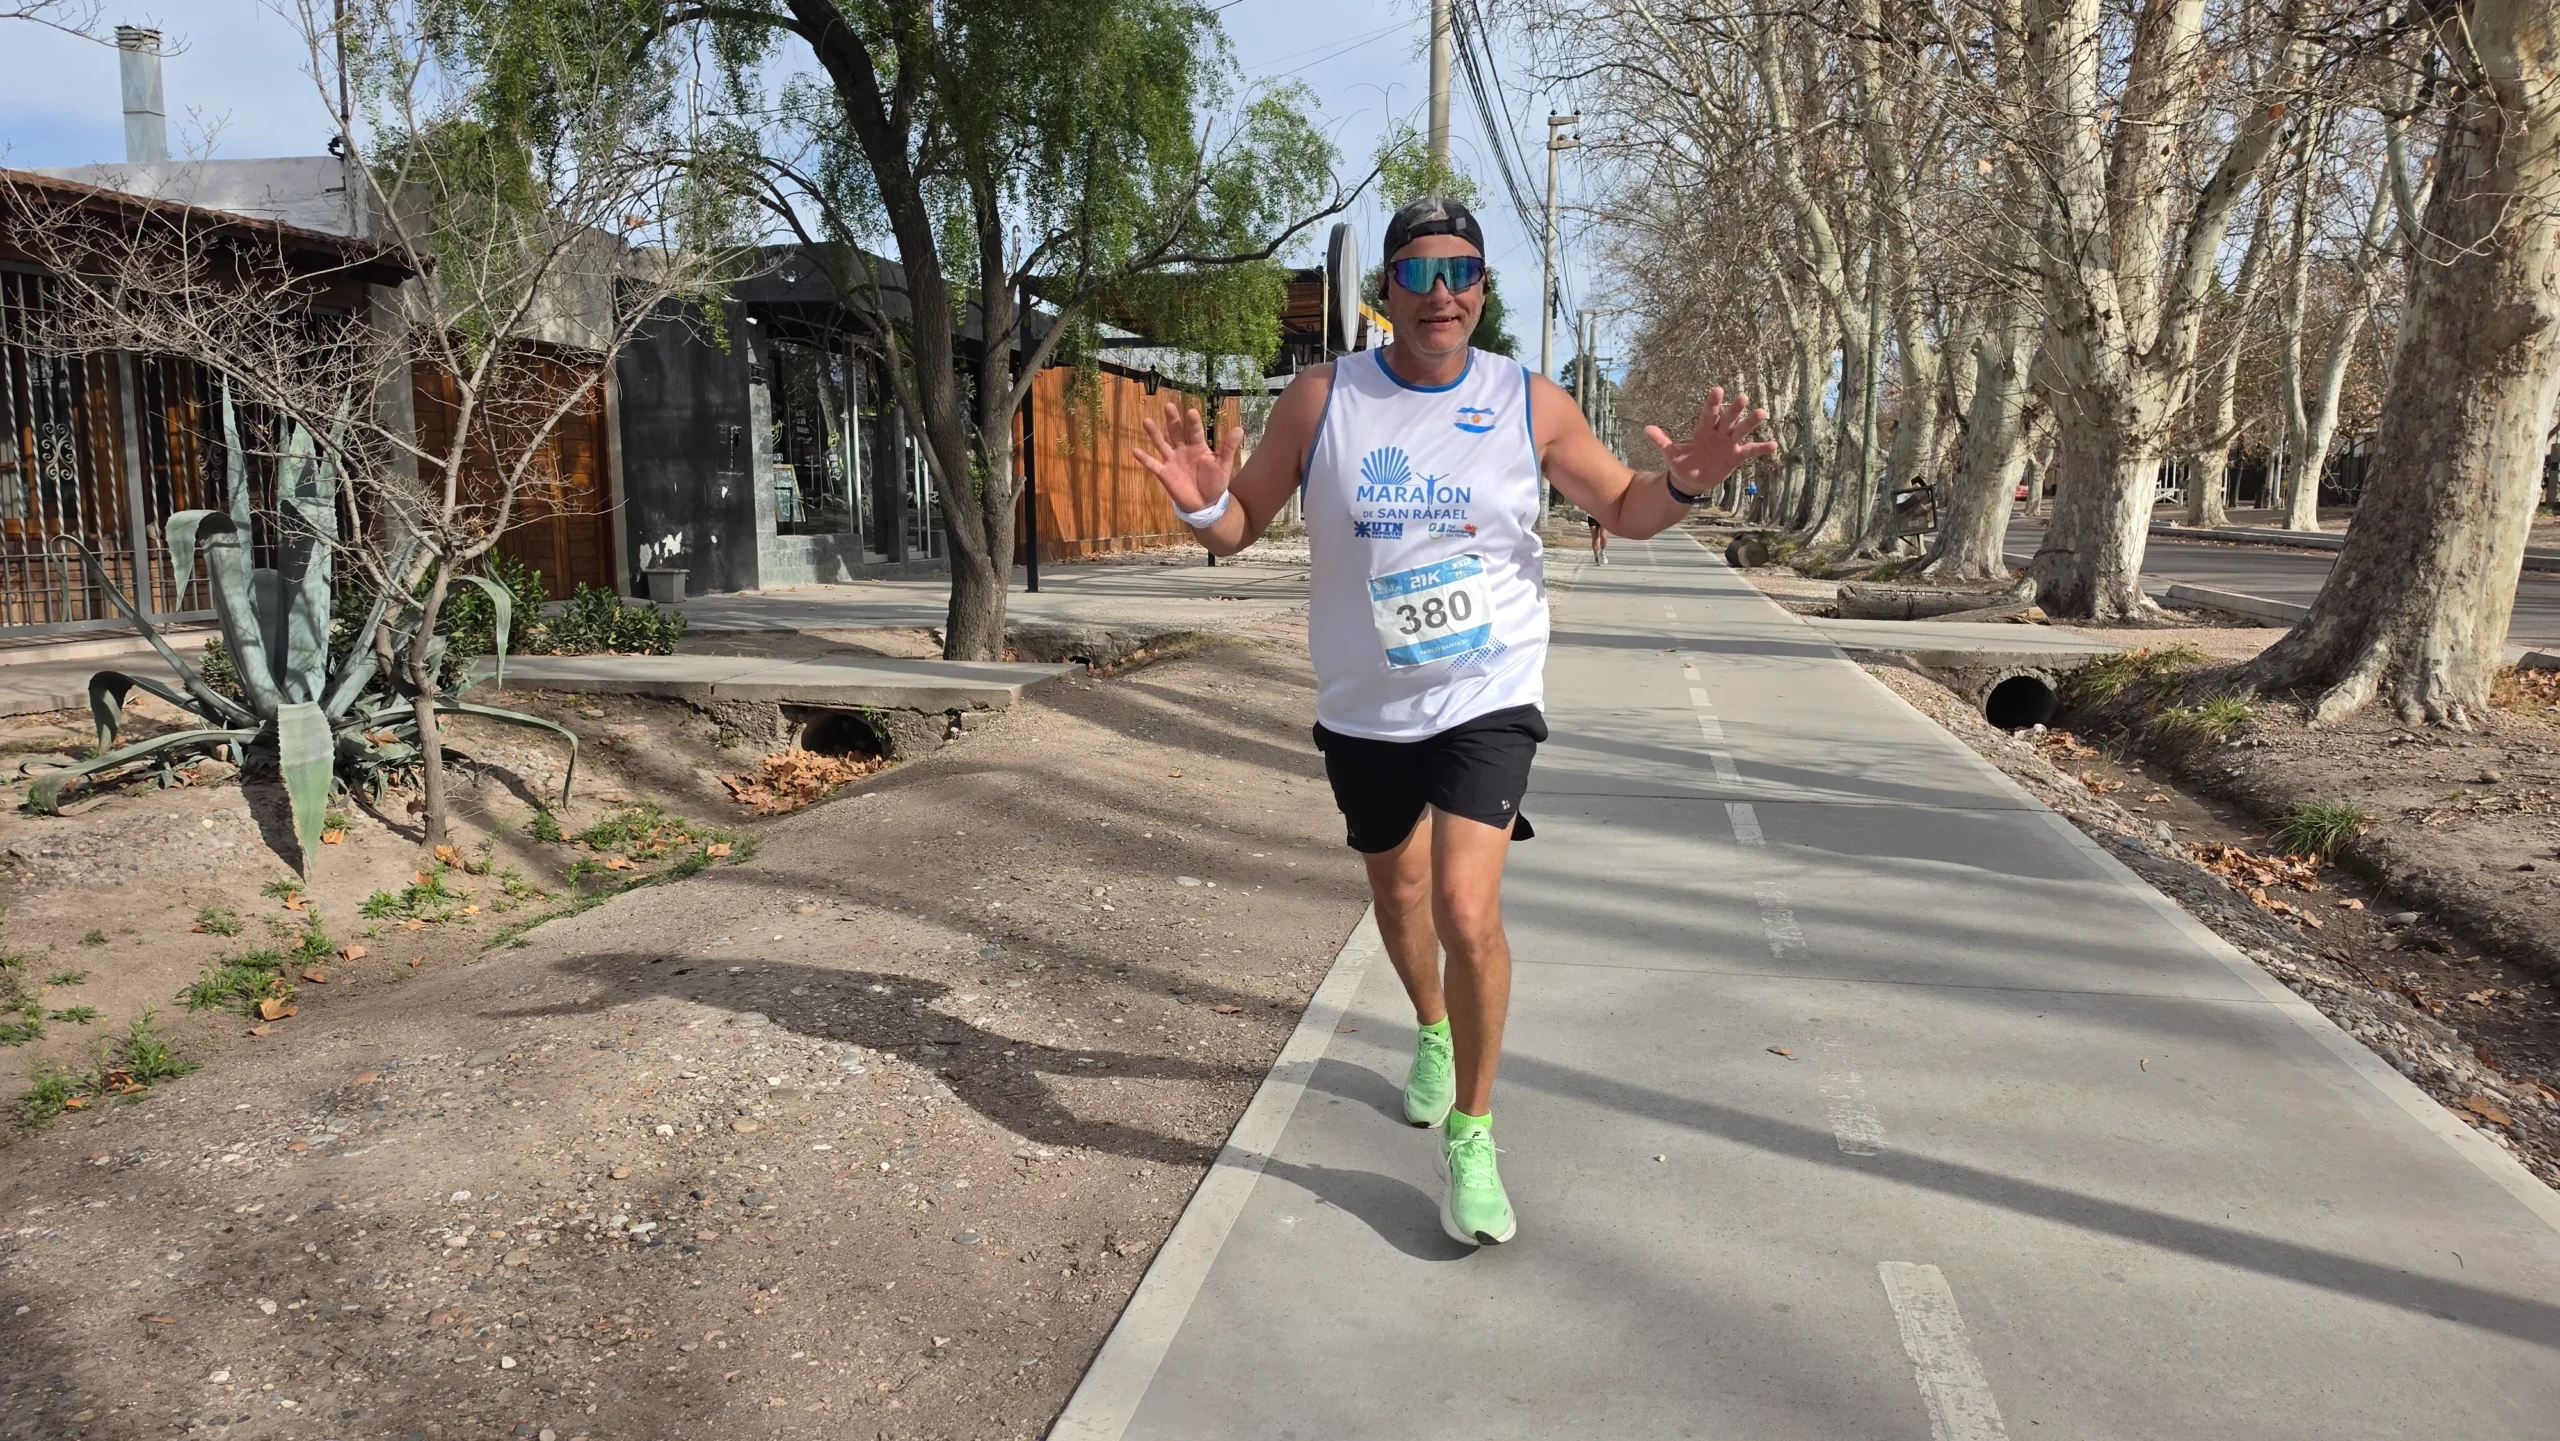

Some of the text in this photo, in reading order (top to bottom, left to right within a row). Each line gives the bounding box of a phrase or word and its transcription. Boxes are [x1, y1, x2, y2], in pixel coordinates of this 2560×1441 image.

[1363, 508, 1468, 520] DE SAN RAFAEL
[1371, 522, 1403, 531] UTN
[1409, 569, 1442, 590] 21K
[1396, 590, 1472, 635] 380
[1419, 646, 1441, 656] PABLO
